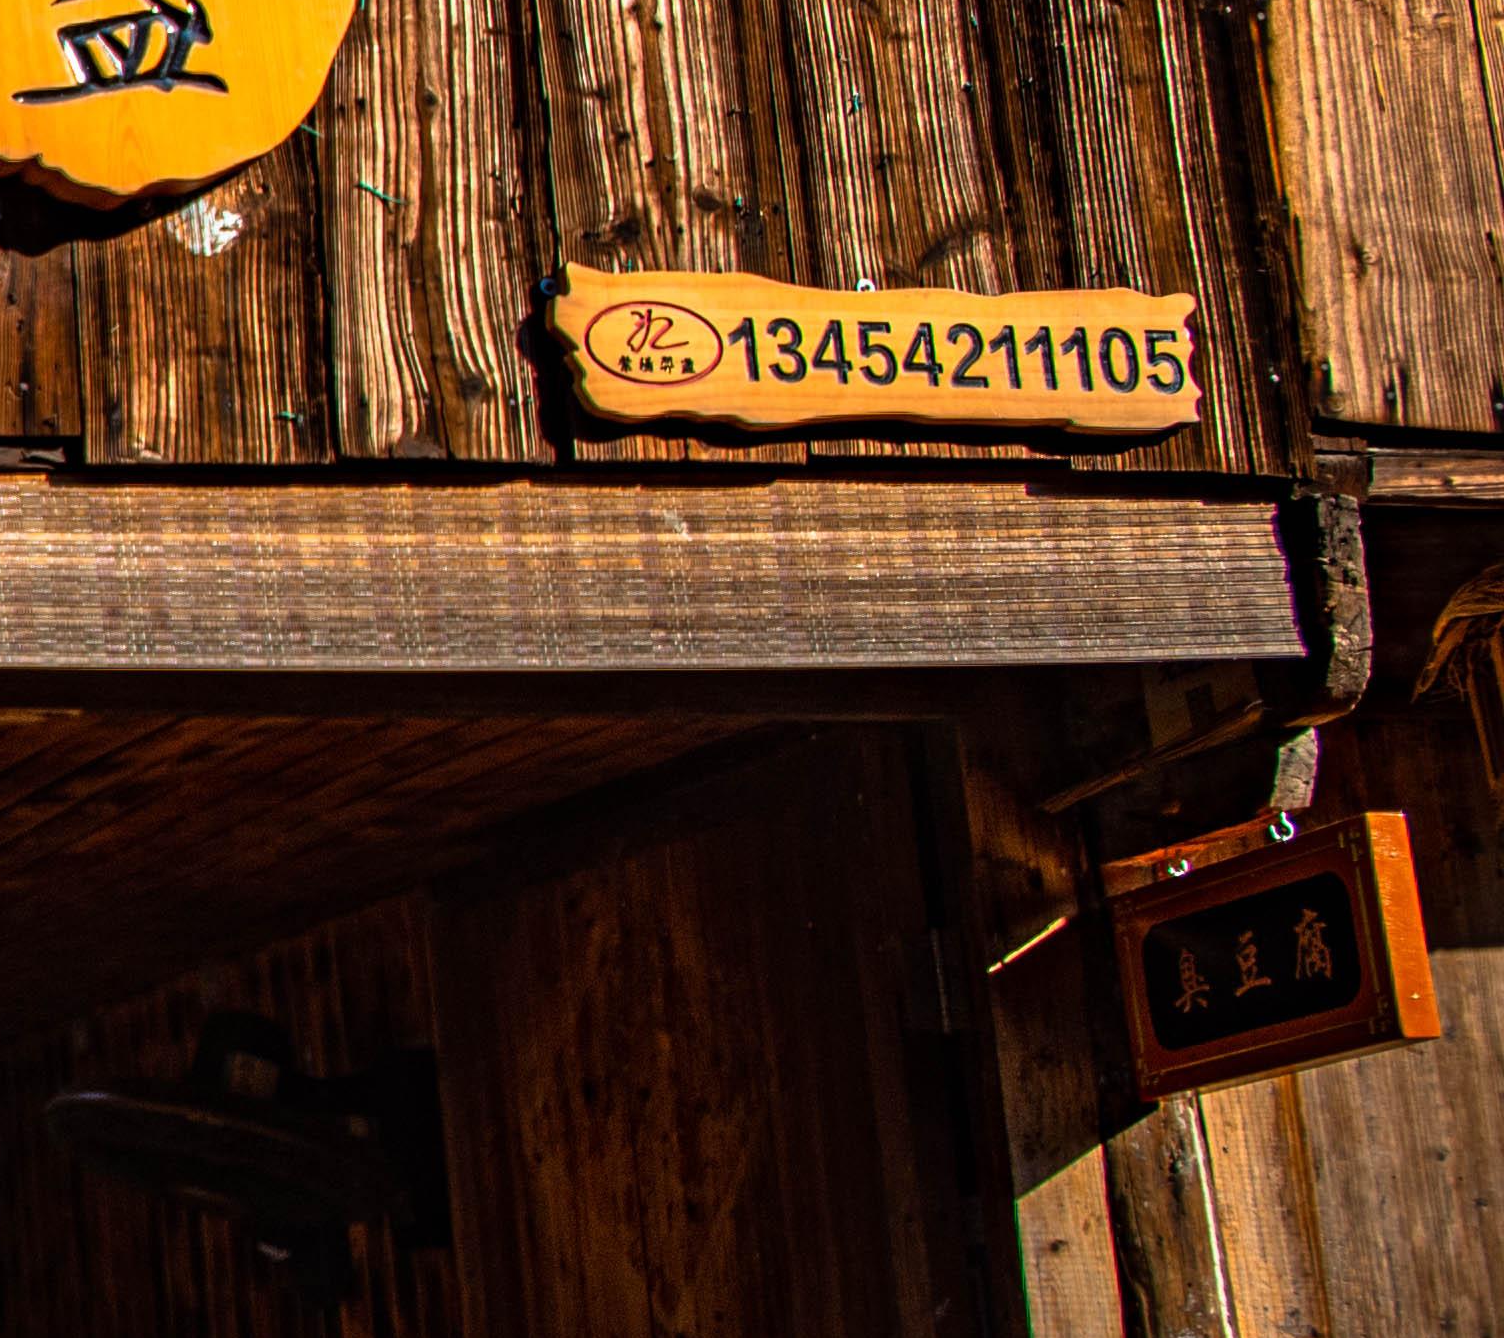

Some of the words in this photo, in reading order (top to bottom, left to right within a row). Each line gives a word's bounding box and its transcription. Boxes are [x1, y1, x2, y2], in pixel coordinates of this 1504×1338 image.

[726, 316, 1185, 394] 13454211105
[1170, 907, 1334, 1014] 臭豆腐
